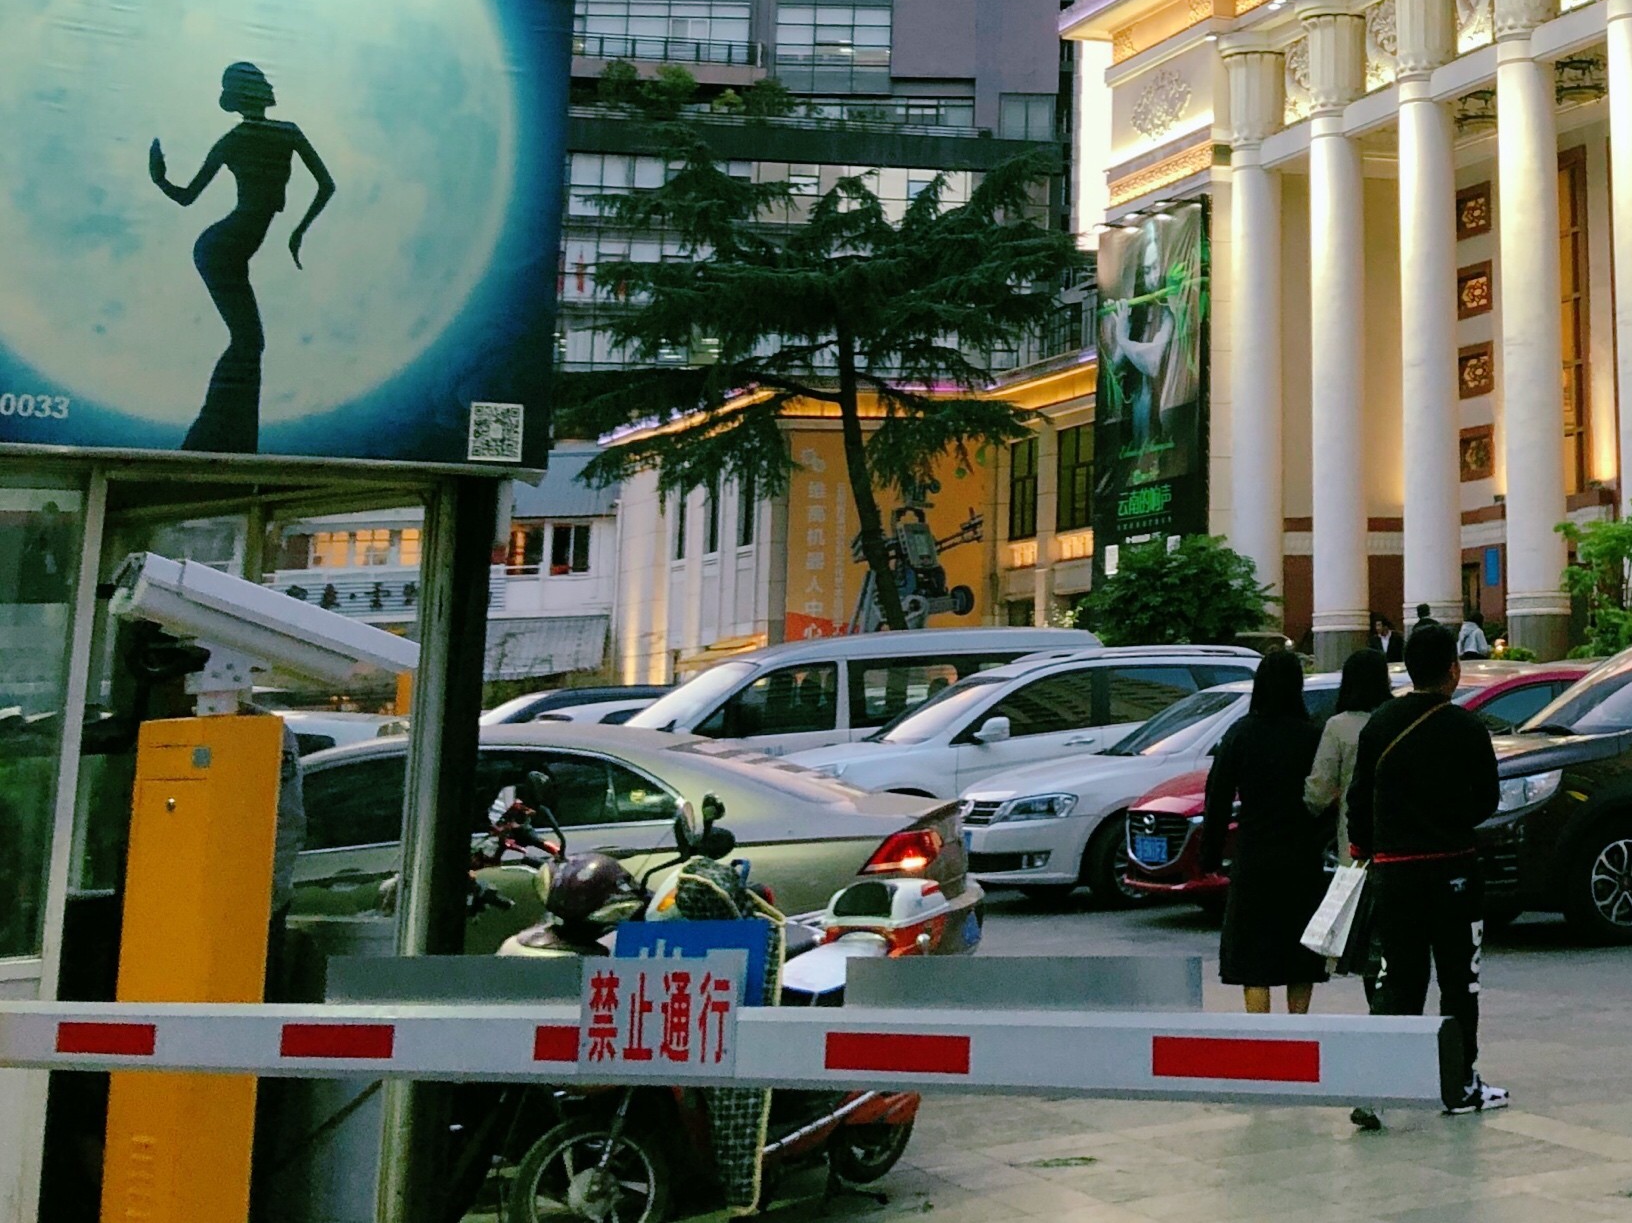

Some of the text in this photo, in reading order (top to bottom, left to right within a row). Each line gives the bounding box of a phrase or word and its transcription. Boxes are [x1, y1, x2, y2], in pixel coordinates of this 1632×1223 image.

[0, 393, 70, 419] 0033
[586, 969, 731, 1064] 禁止通行
